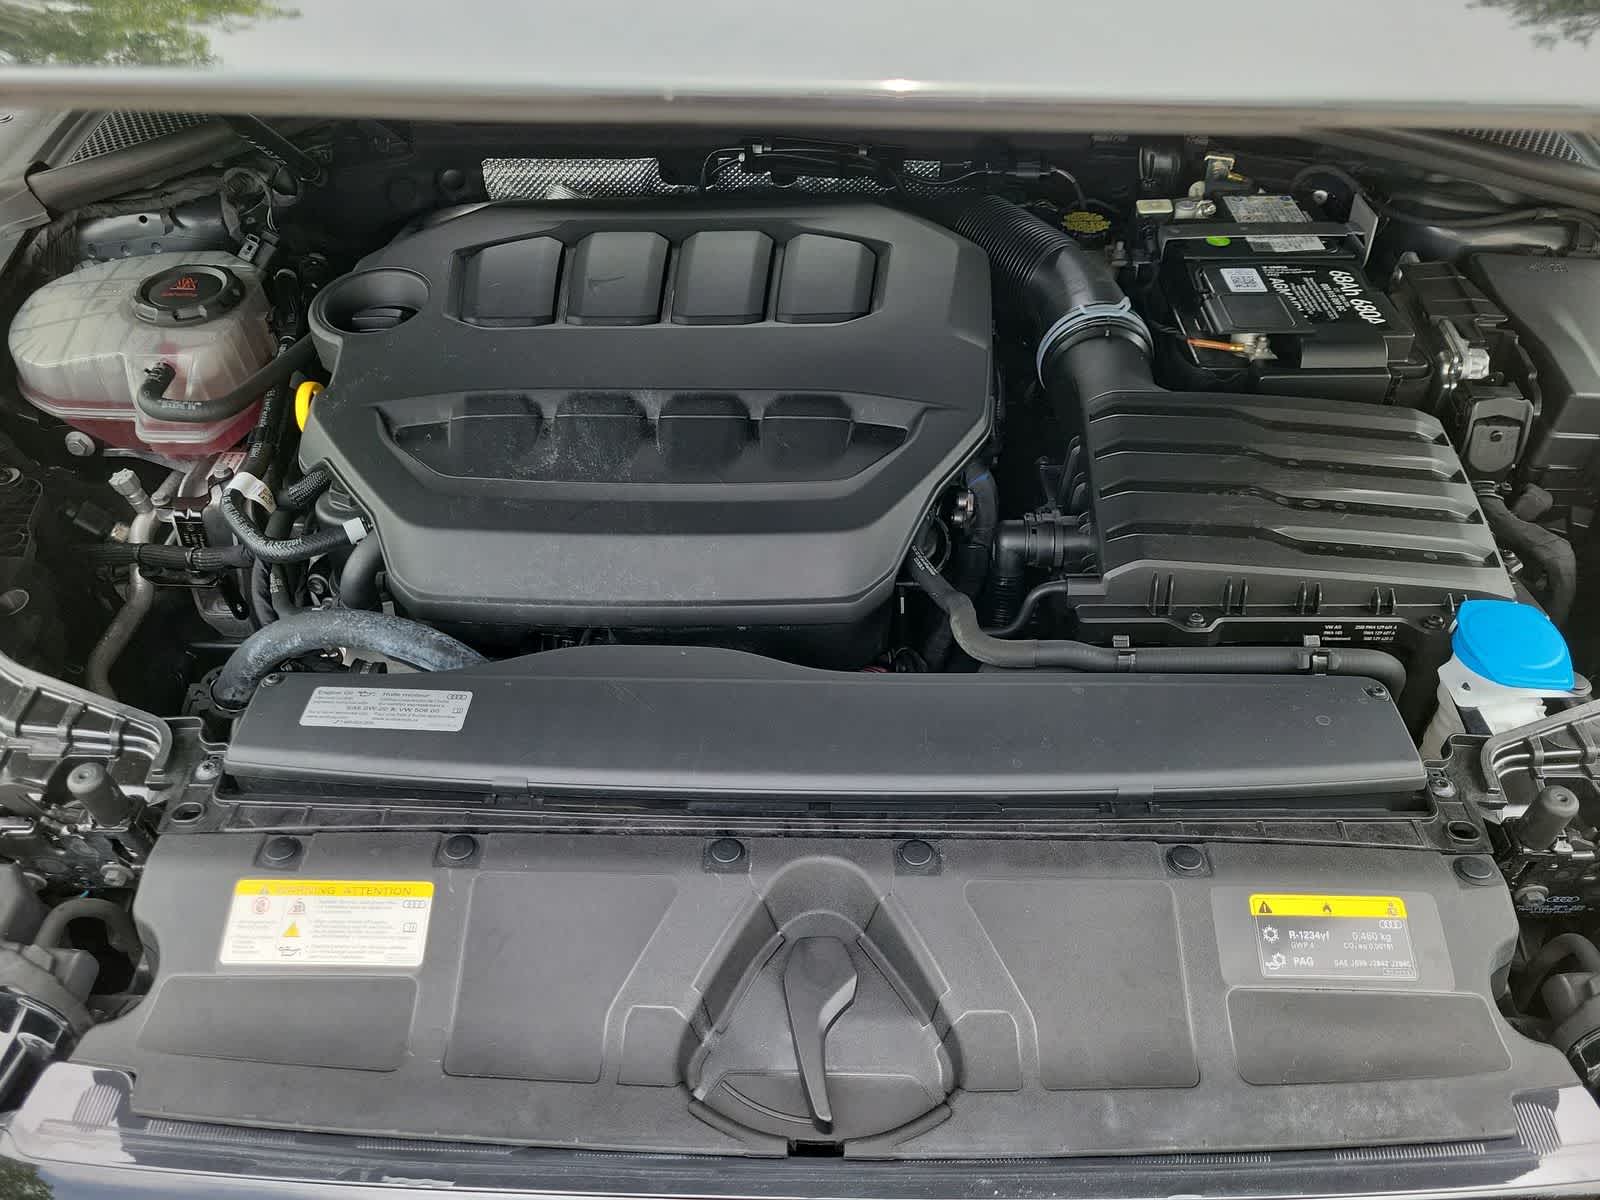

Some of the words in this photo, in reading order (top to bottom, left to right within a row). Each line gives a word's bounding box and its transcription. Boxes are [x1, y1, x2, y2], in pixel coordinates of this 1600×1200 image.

[1329, 270, 1363, 296] 68Ah
[1350, 299, 1386, 324] 680A
[343, 886, 412, 896] ATTENTION
[1293, 956, 1314, 968] PAG
